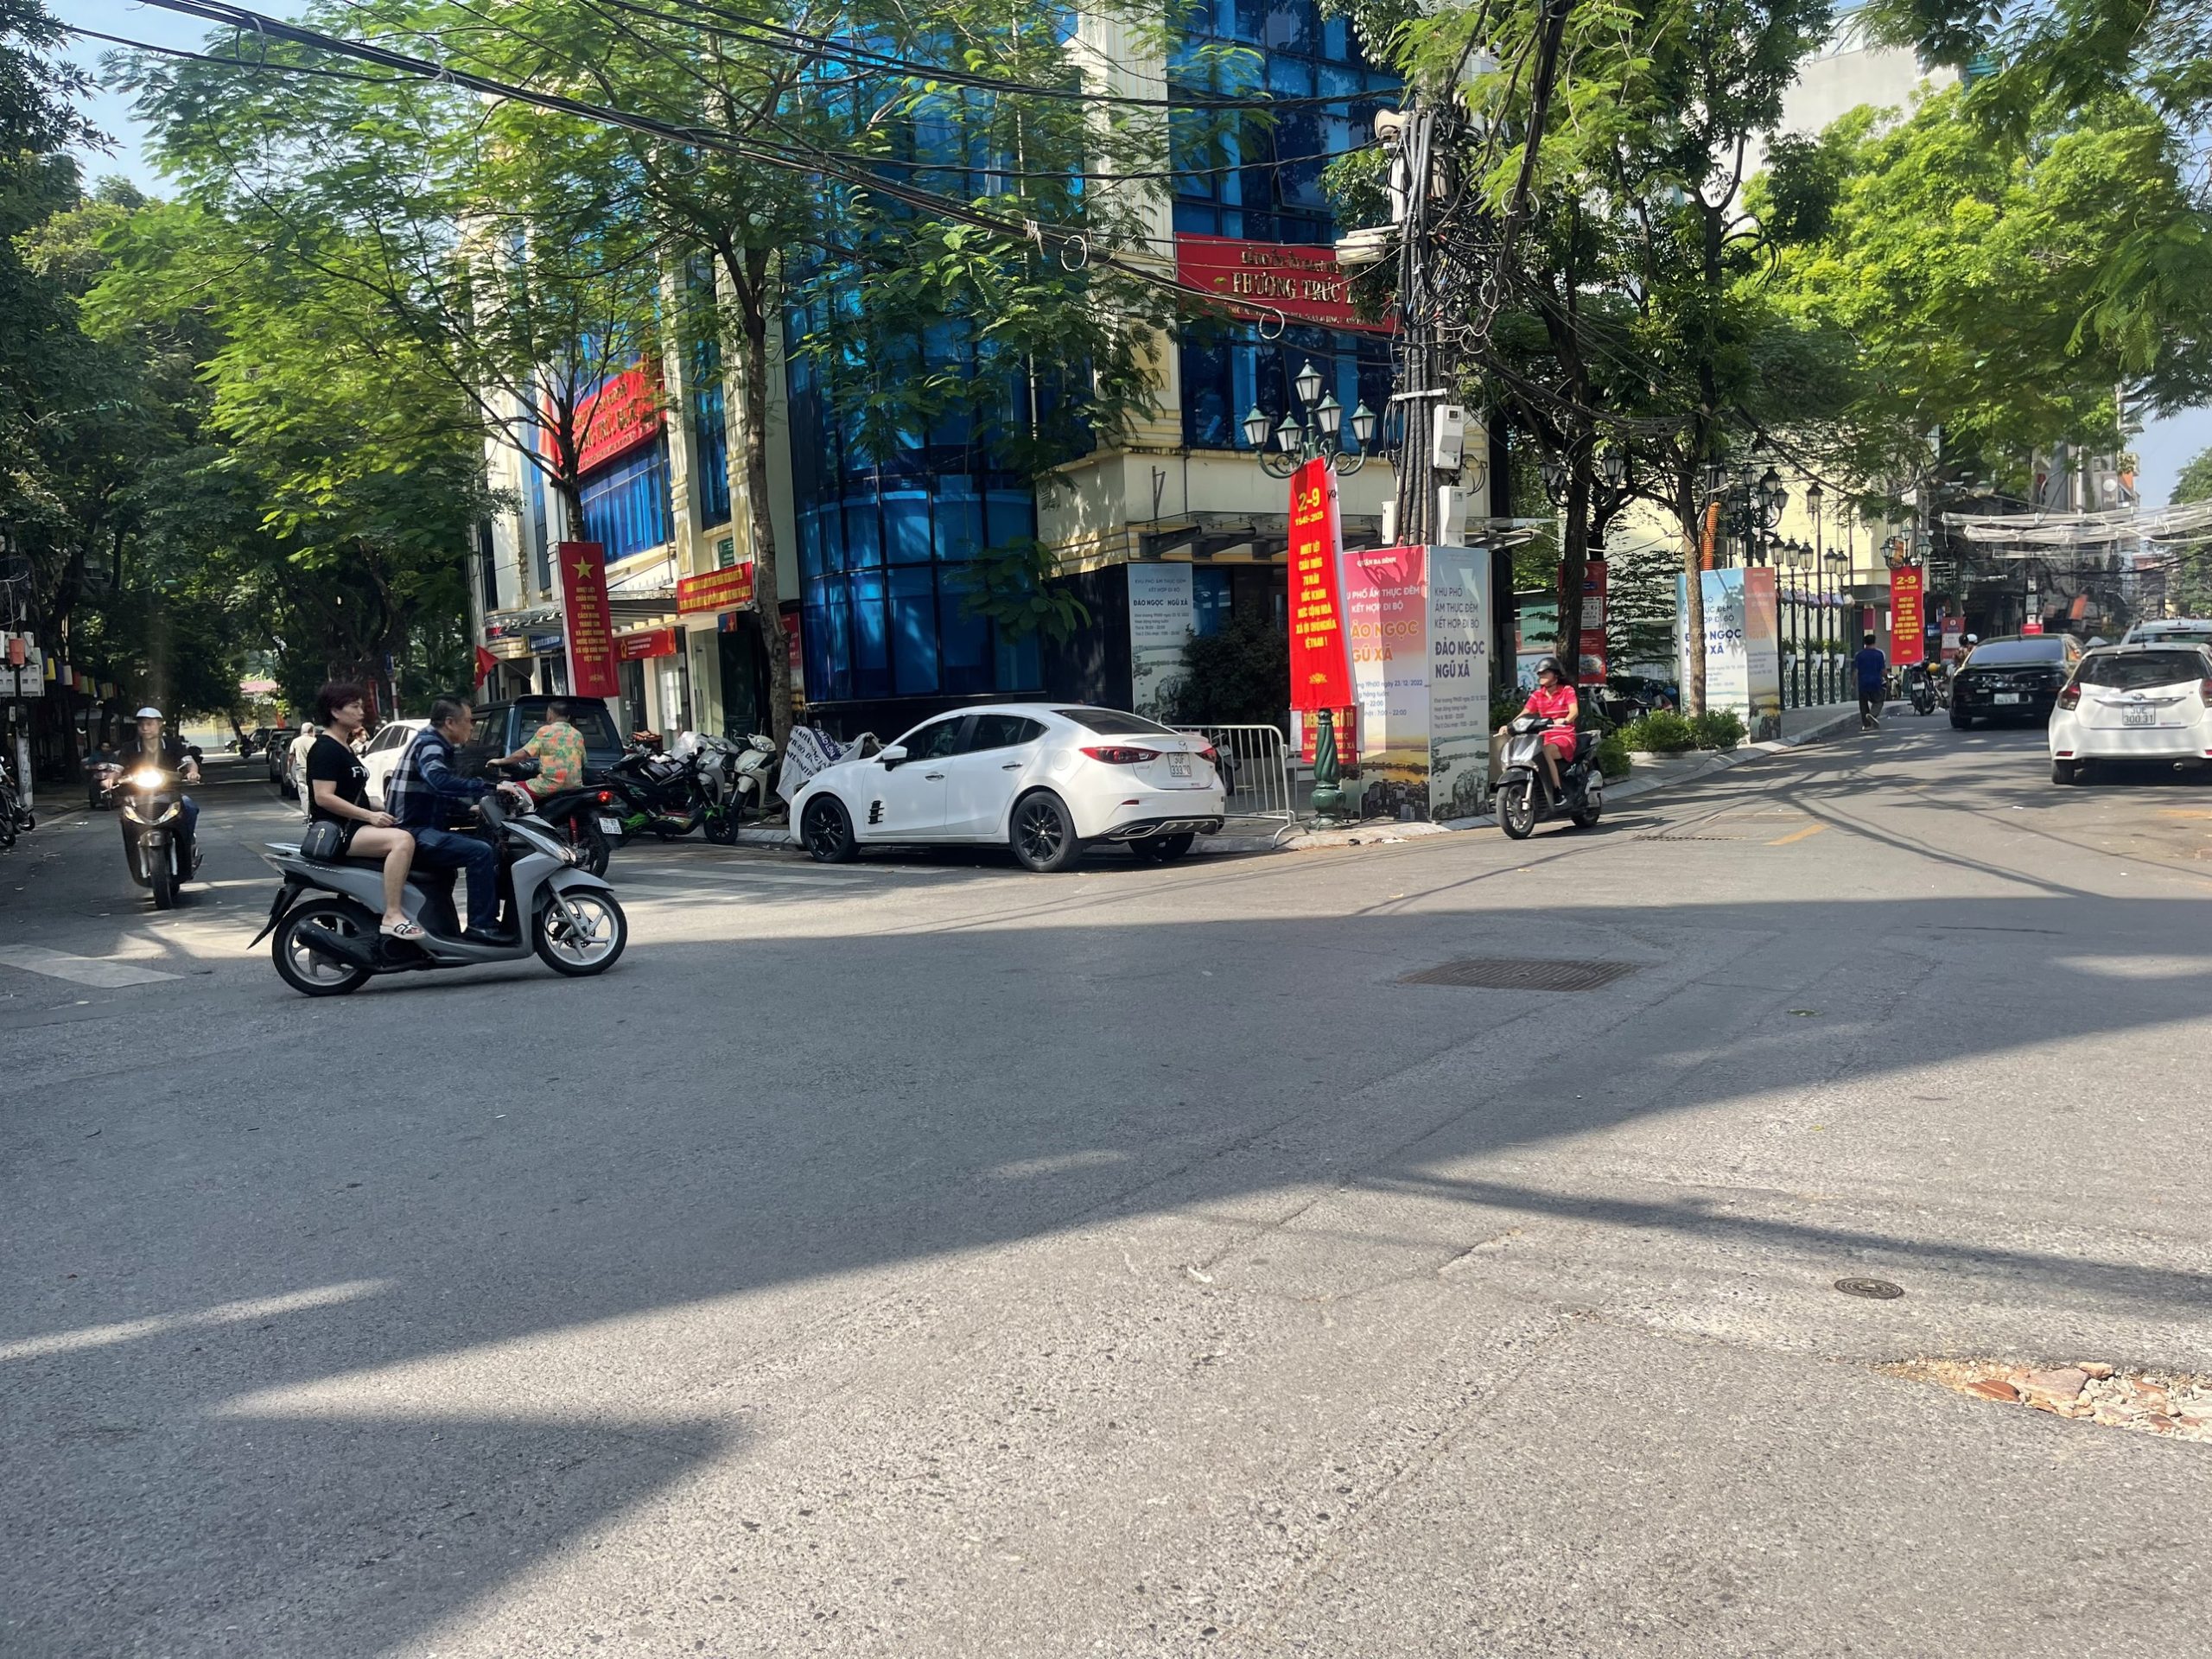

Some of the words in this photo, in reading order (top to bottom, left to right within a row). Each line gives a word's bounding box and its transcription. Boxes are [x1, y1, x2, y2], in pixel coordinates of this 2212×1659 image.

[1301, 276, 1340, 303] TRÚC
[1298, 487, 1320, 512] 2-9
[1896, 575, 1916, 585] 2-9
[1352, 588, 1368, 599] PHỐ
[1382, 588, 1402, 599] THỰC
[1403, 585, 1421, 595] ĐÊM
[1434, 588, 1447, 596] KHU
[1449, 584, 1463, 597] PHỐ
[1351, 602, 1364, 613] KẾT
[1366, 603, 1380, 614] HỢP
[1382, 602, 1391, 611] ĐI
[1392, 601, 1404, 612] BỘ
[1465, 601, 1478, 613] ĐÊM
[1351, 620, 1371, 638] ẢO
[1375, 620, 1418, 639] NGỌC
[1434, 616, 1446, 629] KẾT
[1447, 619, 1461, 632] HỢP
[1471, 618, 1479, 632] BỘ
[1710, 629, 1741, 642] NGỌC
[1353, 645, 1370, 663] GŨ
[1374, 644, 1394, 662] XÃ
[1435, 637, 1456, 656] ĐẢO
[1458, 640, 1485, 659] NGỌC
[1710, 643, 1724, 654] XÃ
[1435, 660, 1456, 678] NGŨ
[1458, 659, 1470, 678] XÃ
[2124, 715, 2153, 724] 300.31
